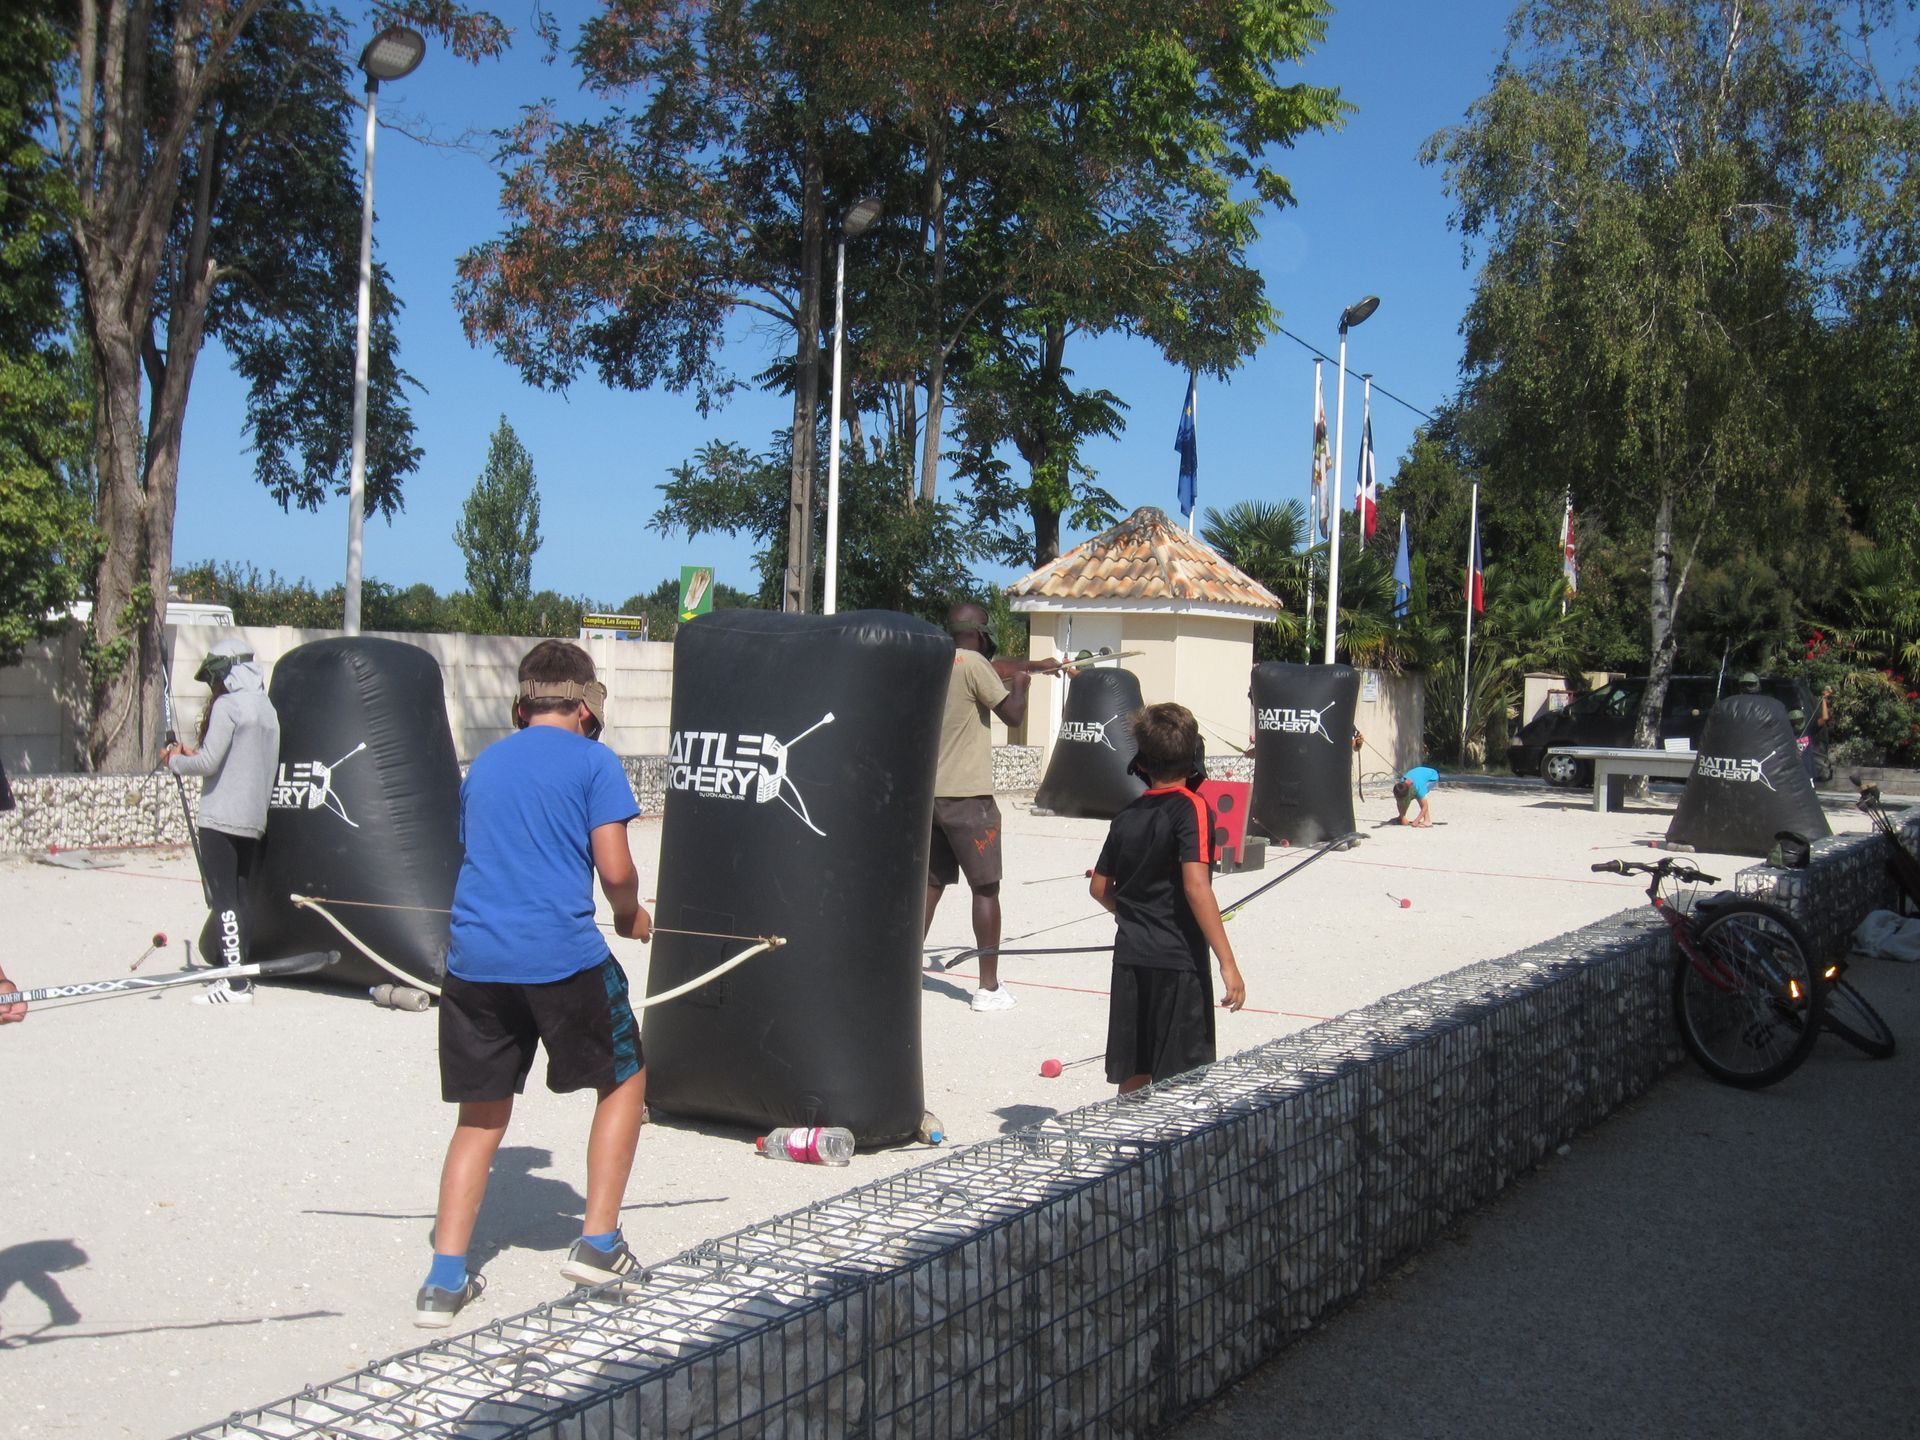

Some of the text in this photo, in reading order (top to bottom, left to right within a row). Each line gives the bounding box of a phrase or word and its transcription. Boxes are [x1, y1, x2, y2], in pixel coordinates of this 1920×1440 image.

[1259, 709, 1310, 722] BATTLE
[1061, 721, 1096, 733] ATTLE
[1259, 720, 1309, 733] ARCHERY
[669, 731, 762, 769] ATTLE
[1700, 755, 1751, 771] BATTLE
[278, 763, 312, 787] LE
[668, 765, 758, 796] RCHERY
[1698, 766, 1751, 780] ARCHERY
[271, 787, 309, 805] ERY
[221, 910, 241, 967] didas
